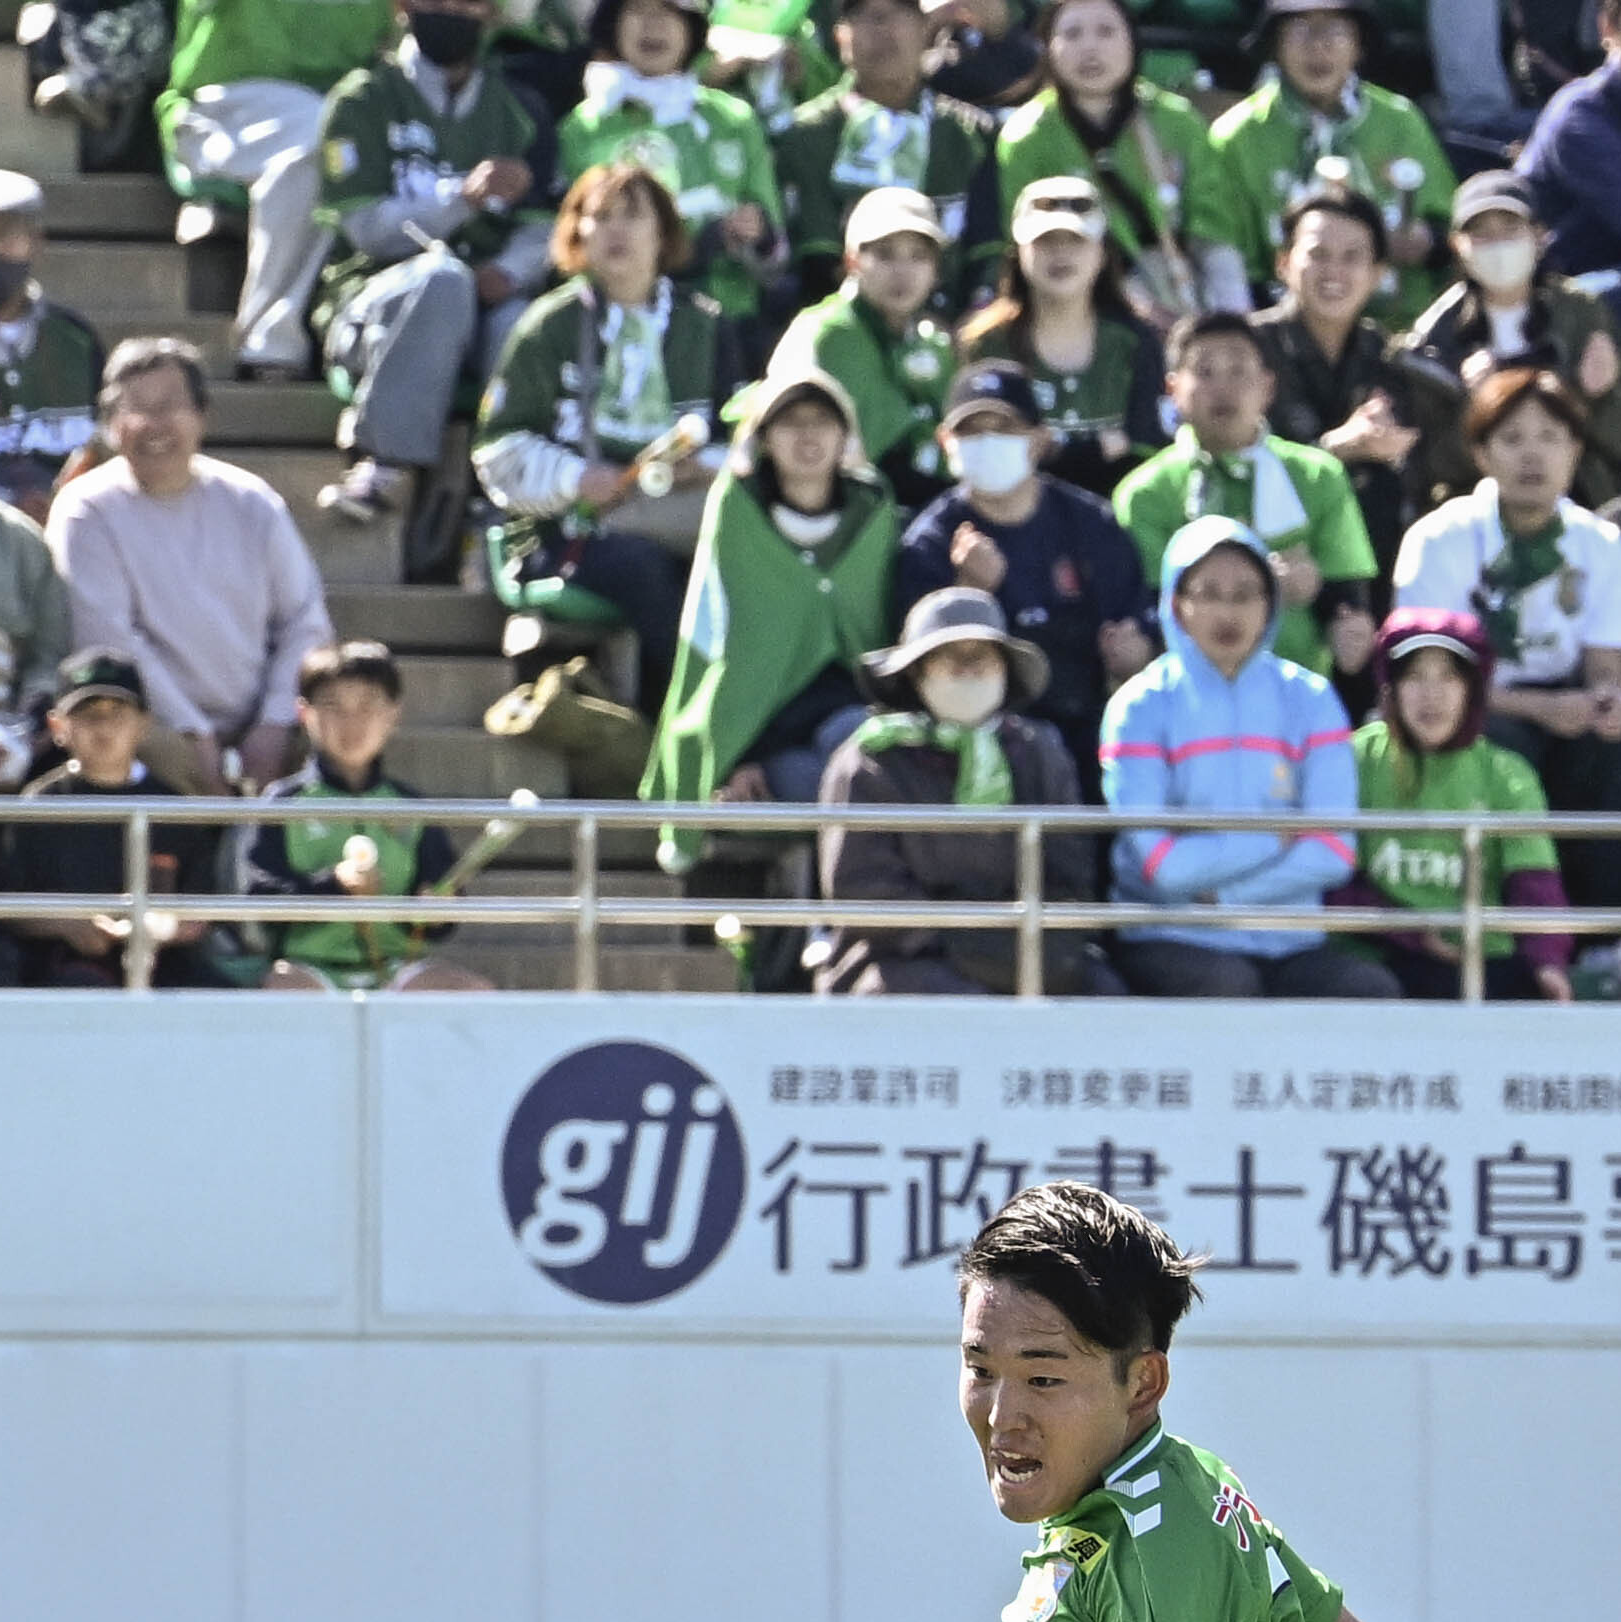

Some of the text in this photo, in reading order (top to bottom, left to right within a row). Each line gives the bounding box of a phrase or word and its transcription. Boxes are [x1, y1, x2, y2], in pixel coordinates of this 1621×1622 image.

[769, 1065, 960, 1106] 建設業許可
